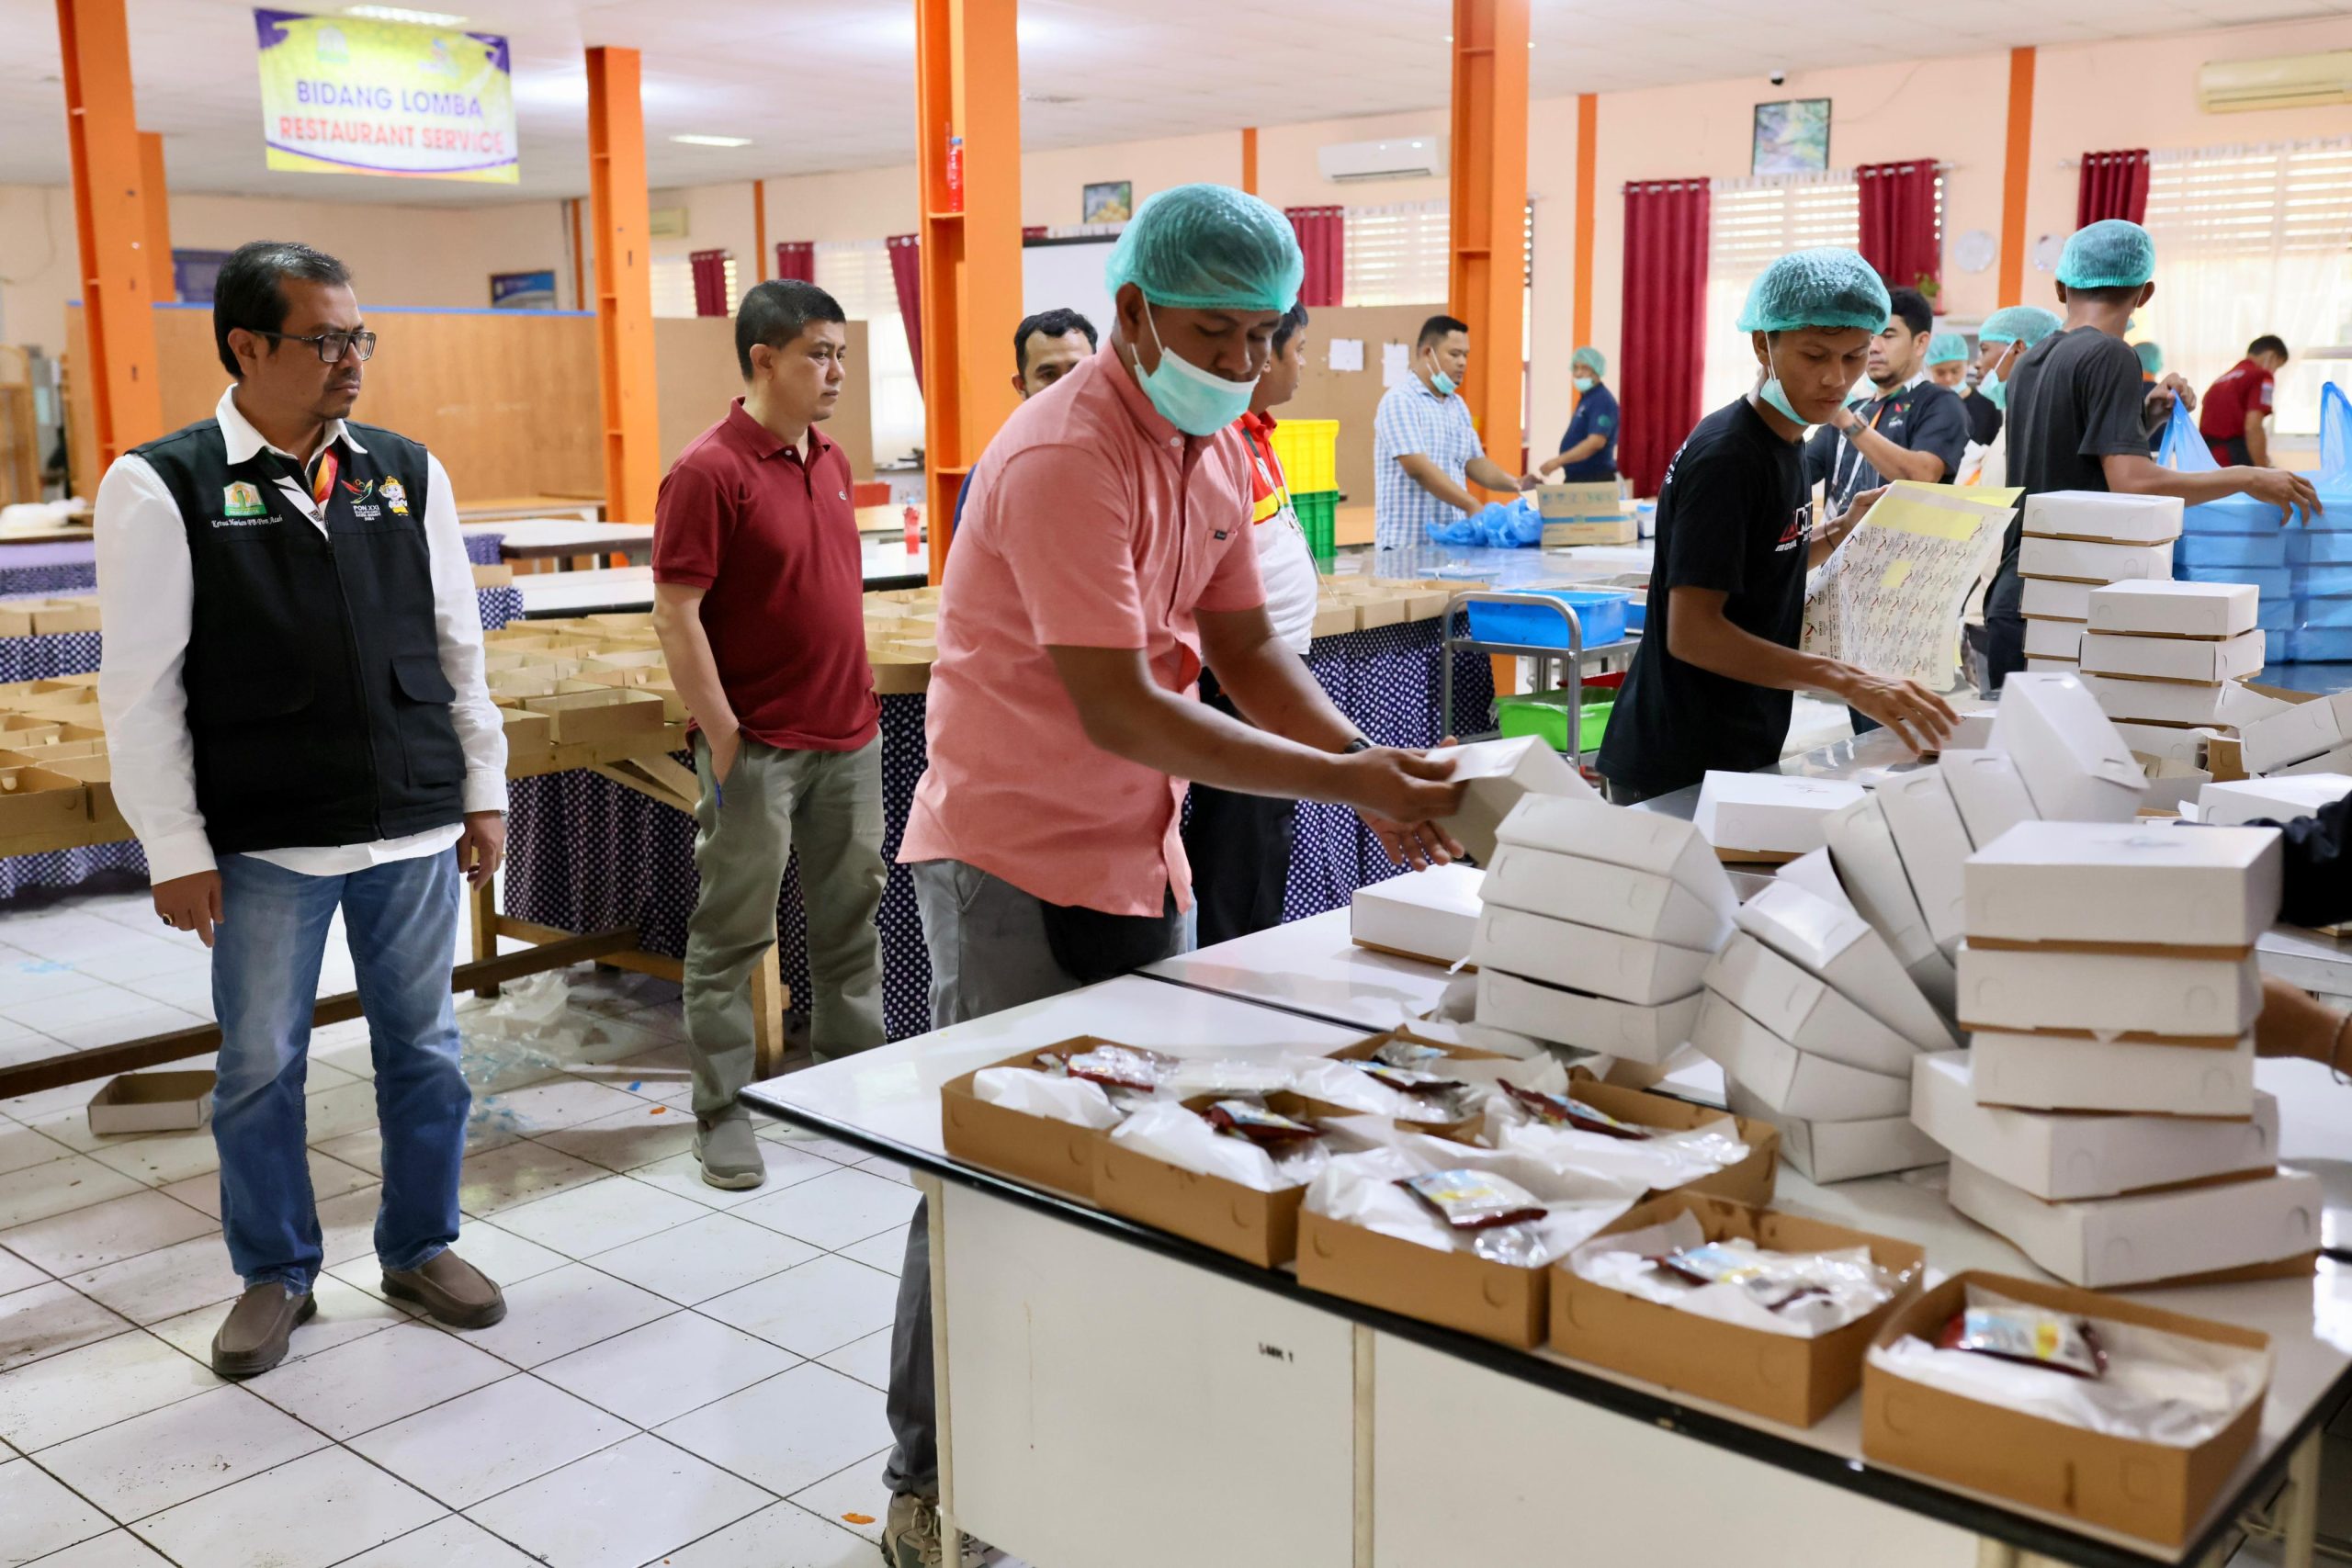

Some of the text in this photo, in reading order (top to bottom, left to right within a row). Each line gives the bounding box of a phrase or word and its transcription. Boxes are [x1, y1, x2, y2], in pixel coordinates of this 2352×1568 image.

[297, 80, 483, 118] BIDANG LOMBA
[279, 116, 504, 154] RESTAURANT SERVICE
